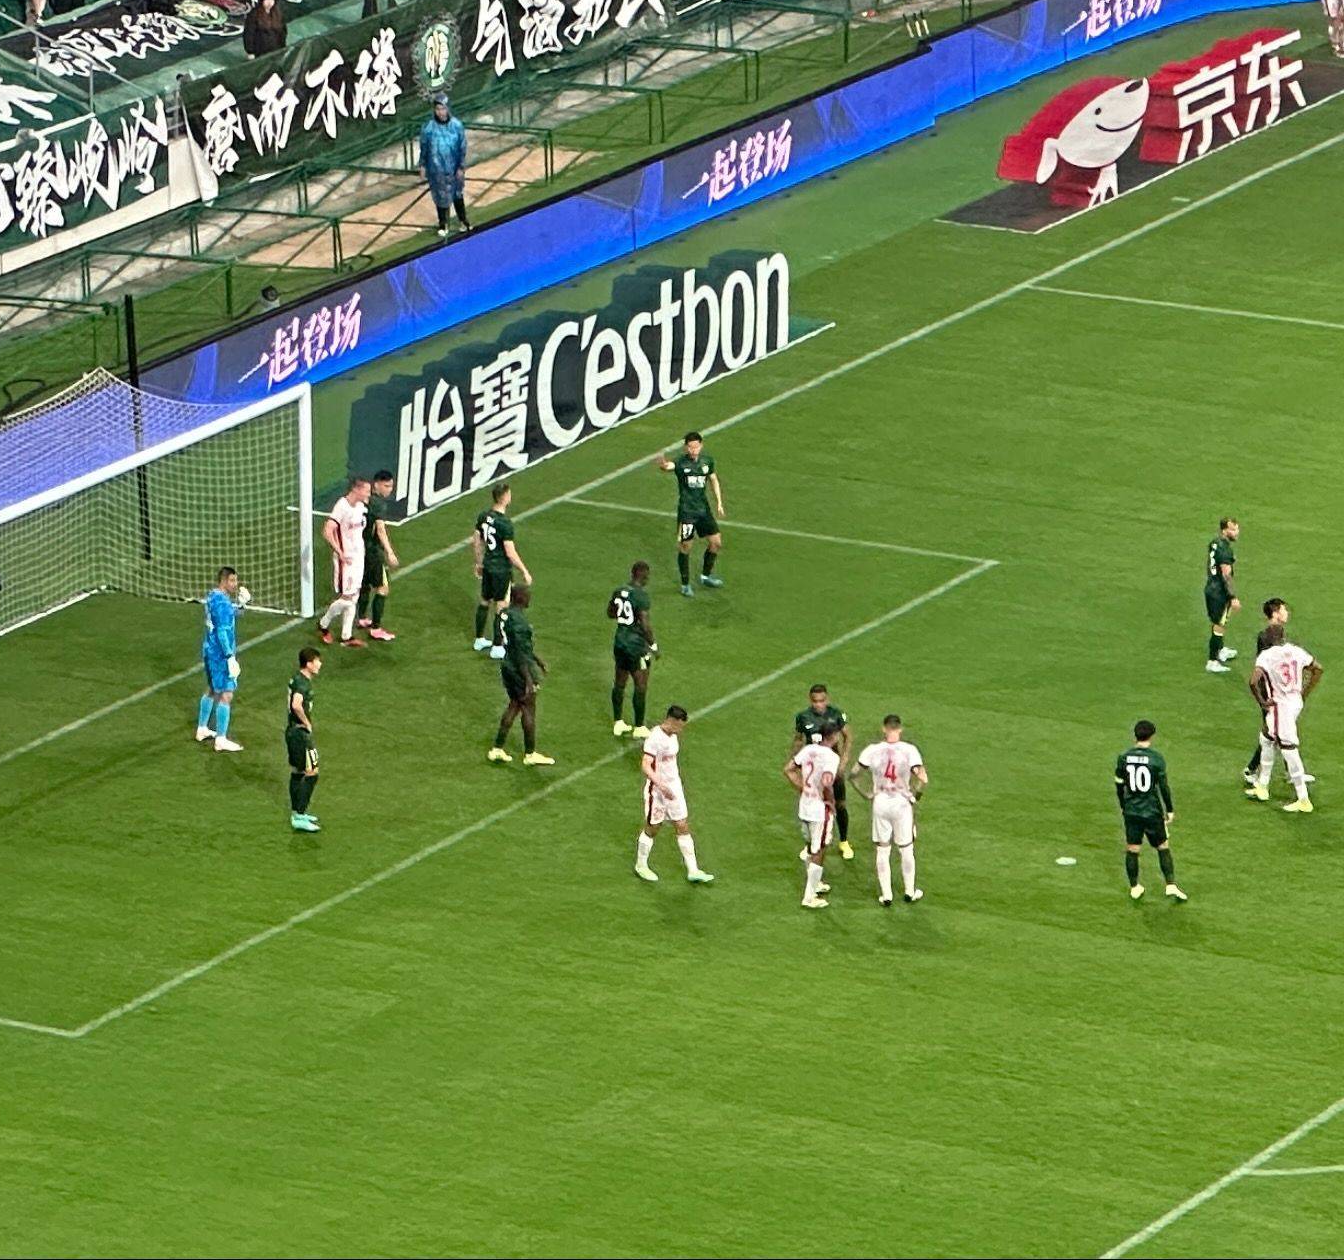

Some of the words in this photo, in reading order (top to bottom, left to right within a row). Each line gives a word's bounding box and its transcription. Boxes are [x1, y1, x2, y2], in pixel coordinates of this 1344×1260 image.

[1172, 29, 1307, 164] 京东
[682, 118, 792, 207] 一起登场
[237, 293, 362, 390] 一起登场
[536, 251, 791, 449] C'estbon
[481, 522, 497, 551] 15
[613, 597, 635, 626] 29
[884, 758, 897, 783] 4
[1125, 764, 1151, 793] 10
